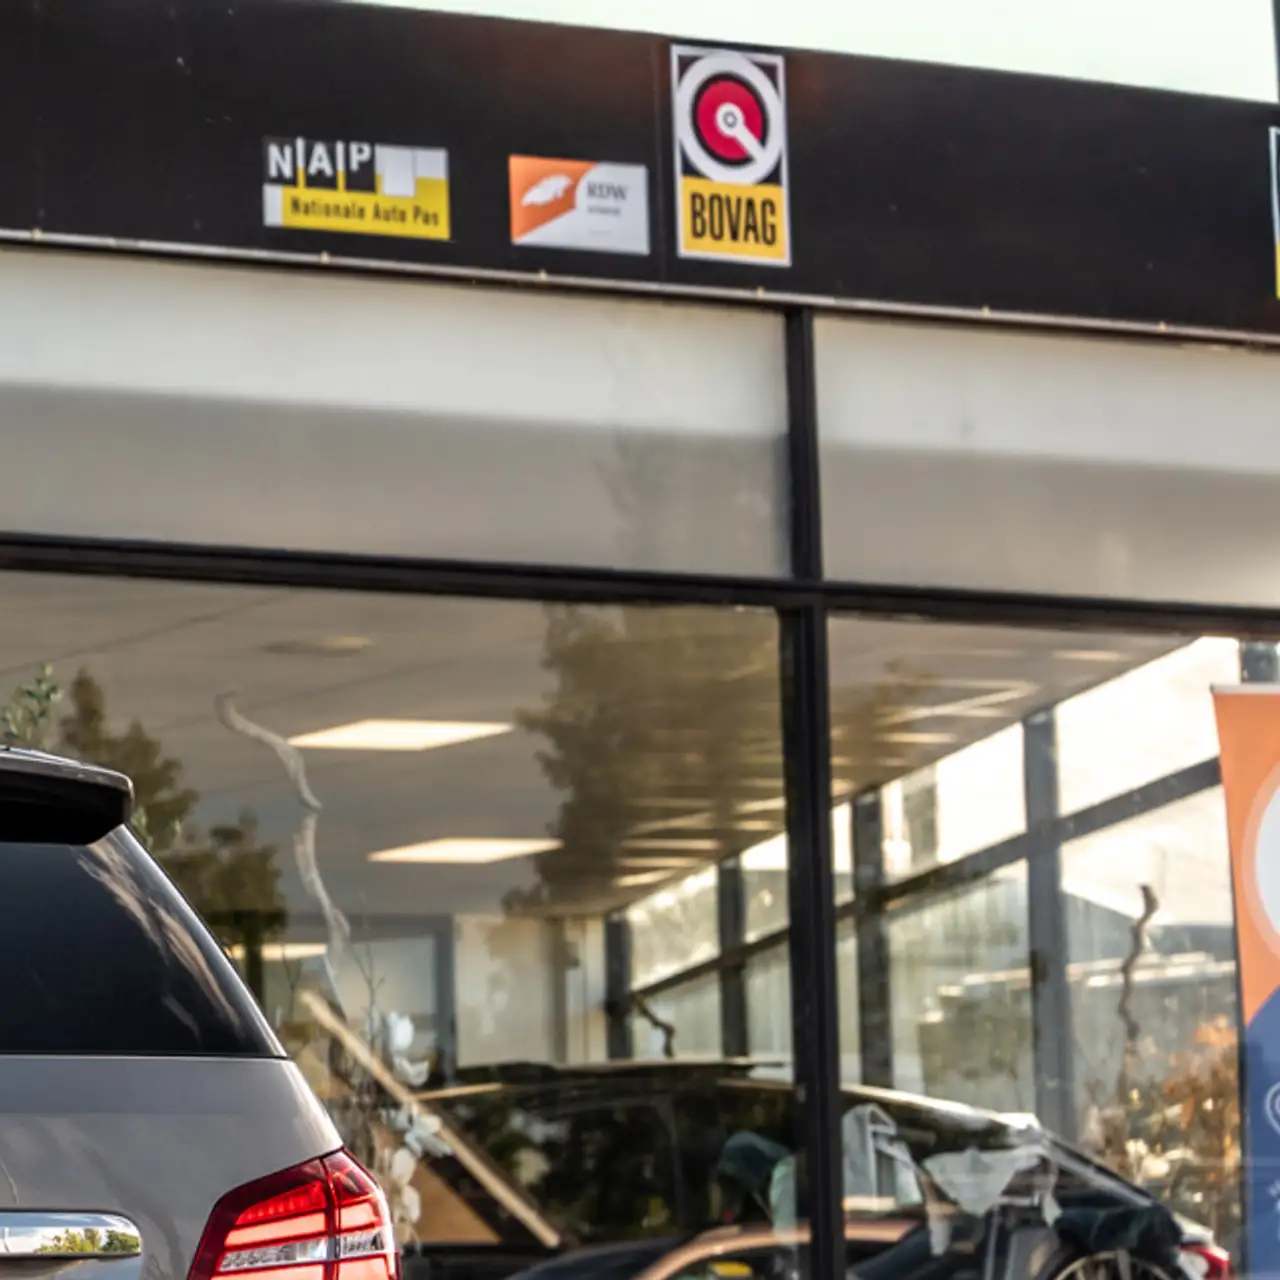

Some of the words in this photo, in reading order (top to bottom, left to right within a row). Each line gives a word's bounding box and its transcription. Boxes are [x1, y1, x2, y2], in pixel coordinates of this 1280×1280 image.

[291, 196, 366, 221] Nationale
[373, 203, 407, 225] Auto
[690, 191, 777, 247] BOVAG
